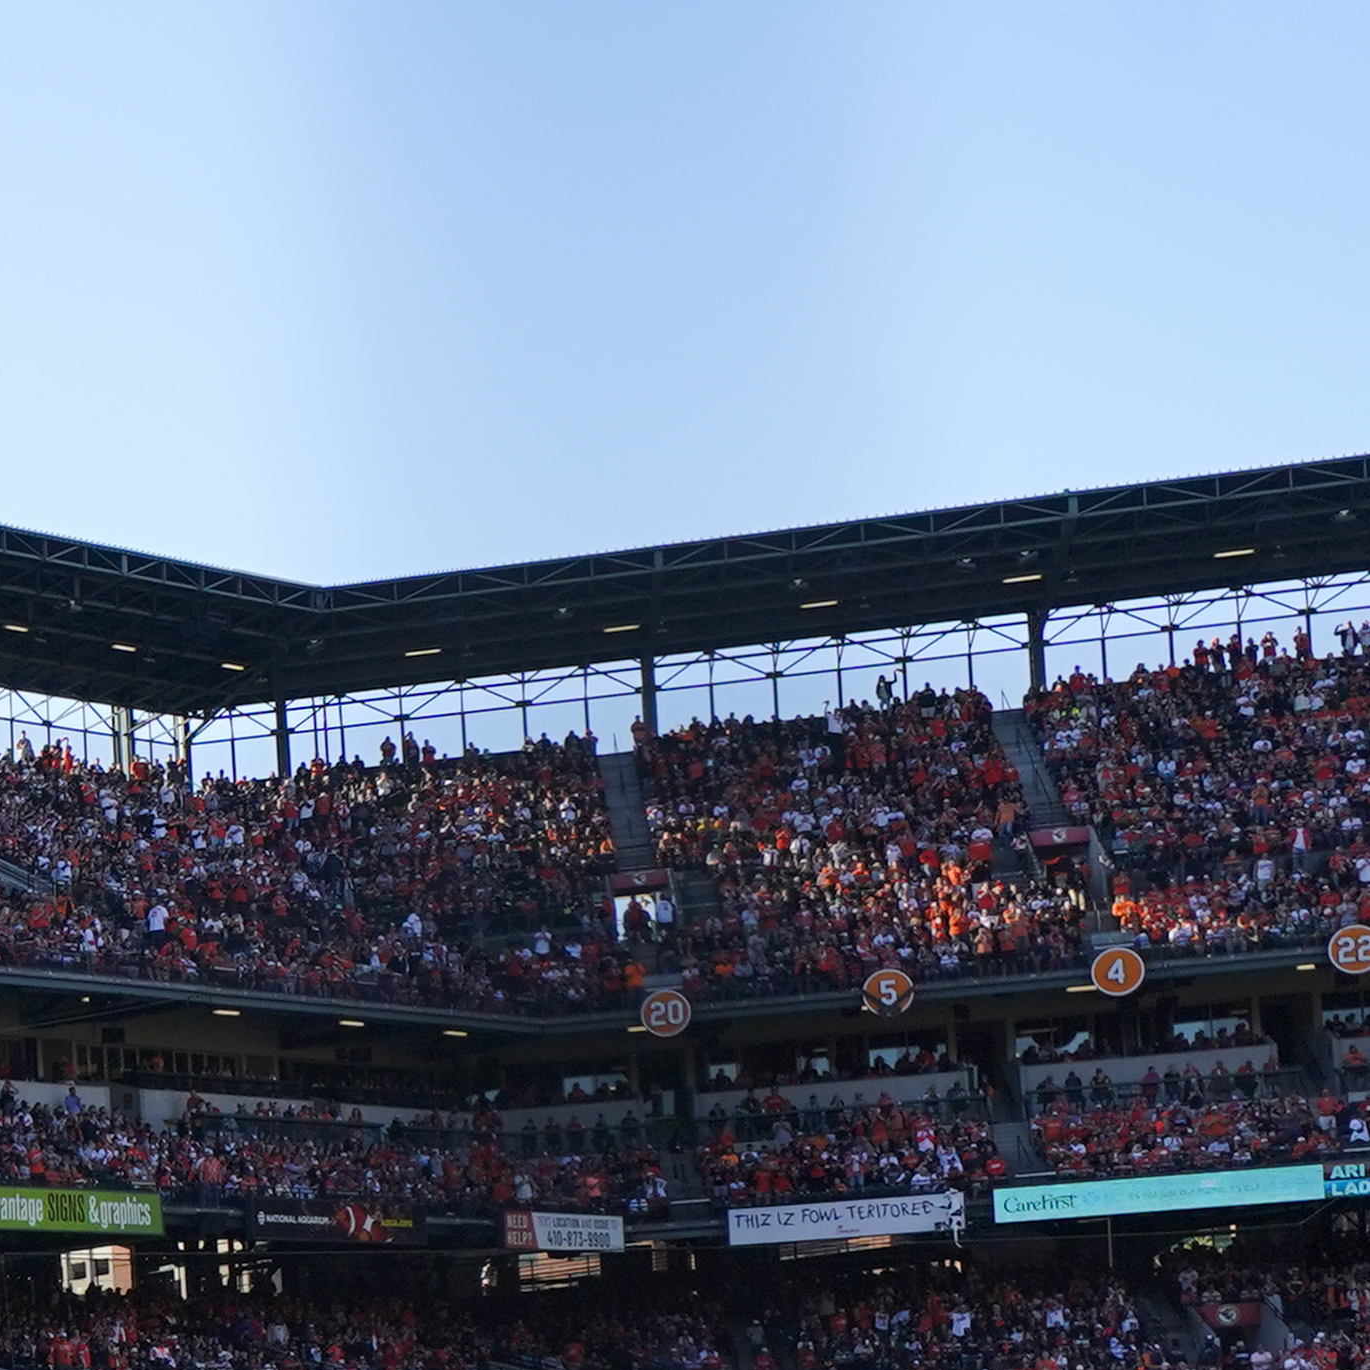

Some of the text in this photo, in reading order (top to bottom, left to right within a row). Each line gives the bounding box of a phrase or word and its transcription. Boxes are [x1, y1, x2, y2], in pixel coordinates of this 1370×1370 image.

[1337, 935, 1370, 963] 22
[1107, 958, 1126, 985] 4
[879, 979, 899, 1006] 5
[650, 999, 684, 1027] 20
[1329, 1163, 1366, 1181] ARI
[1331, 1180, 1370, 1197] LAD
[48, 1192, 86, 1223] SIGNS
[1003, 1194, 1078, 1215] CareFirst
[266, 1214, 297, 1224] NATIONAL
[506, 1214, 529, 1229] NEED
[734, 1213, 772, 1229] THIZ
[777, 1210, 796, 1227] IZ
[801, 1205, 843, 1224] FOWL
[506, 1230, 533, 1246] HELP?
